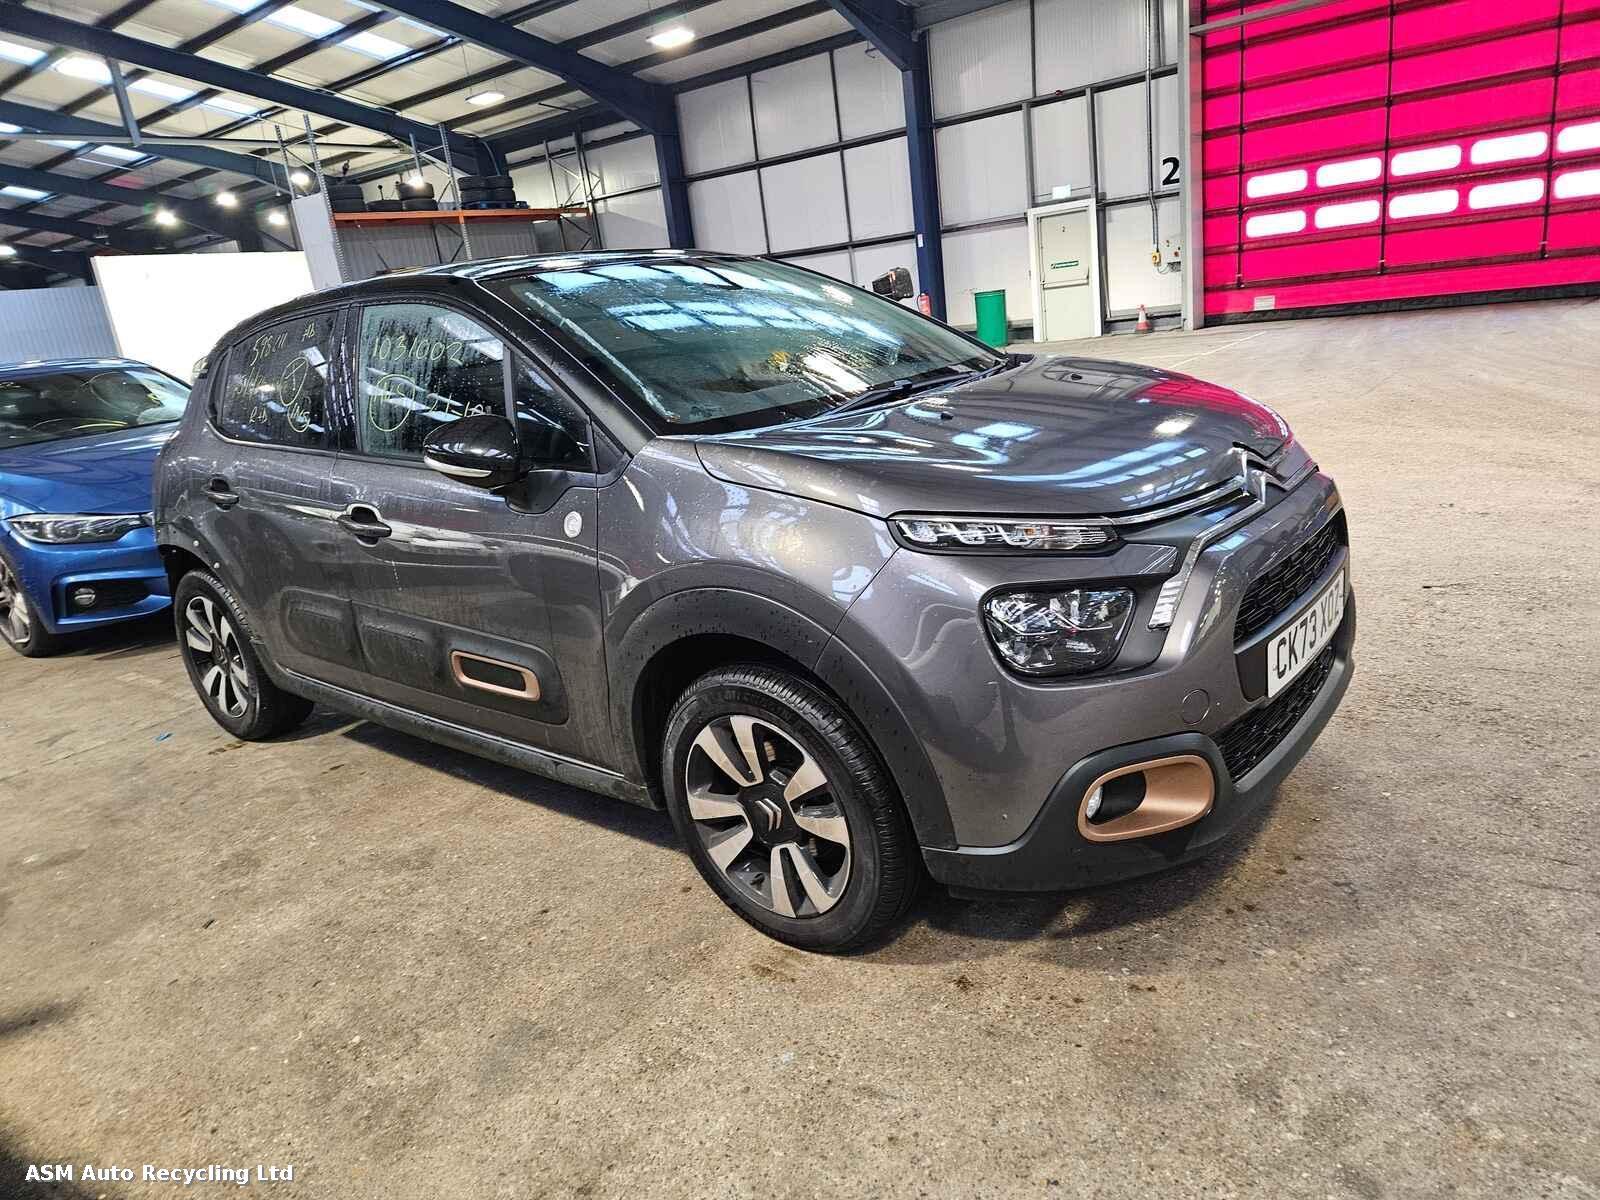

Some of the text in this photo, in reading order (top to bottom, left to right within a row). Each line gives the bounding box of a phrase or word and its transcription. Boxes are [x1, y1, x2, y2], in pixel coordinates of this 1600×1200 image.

[1162, 157, 1180, 186] 2
[373, 336, 465, 366] 1031002
[1277, 580, 1340, 679] CK73 XOZ
